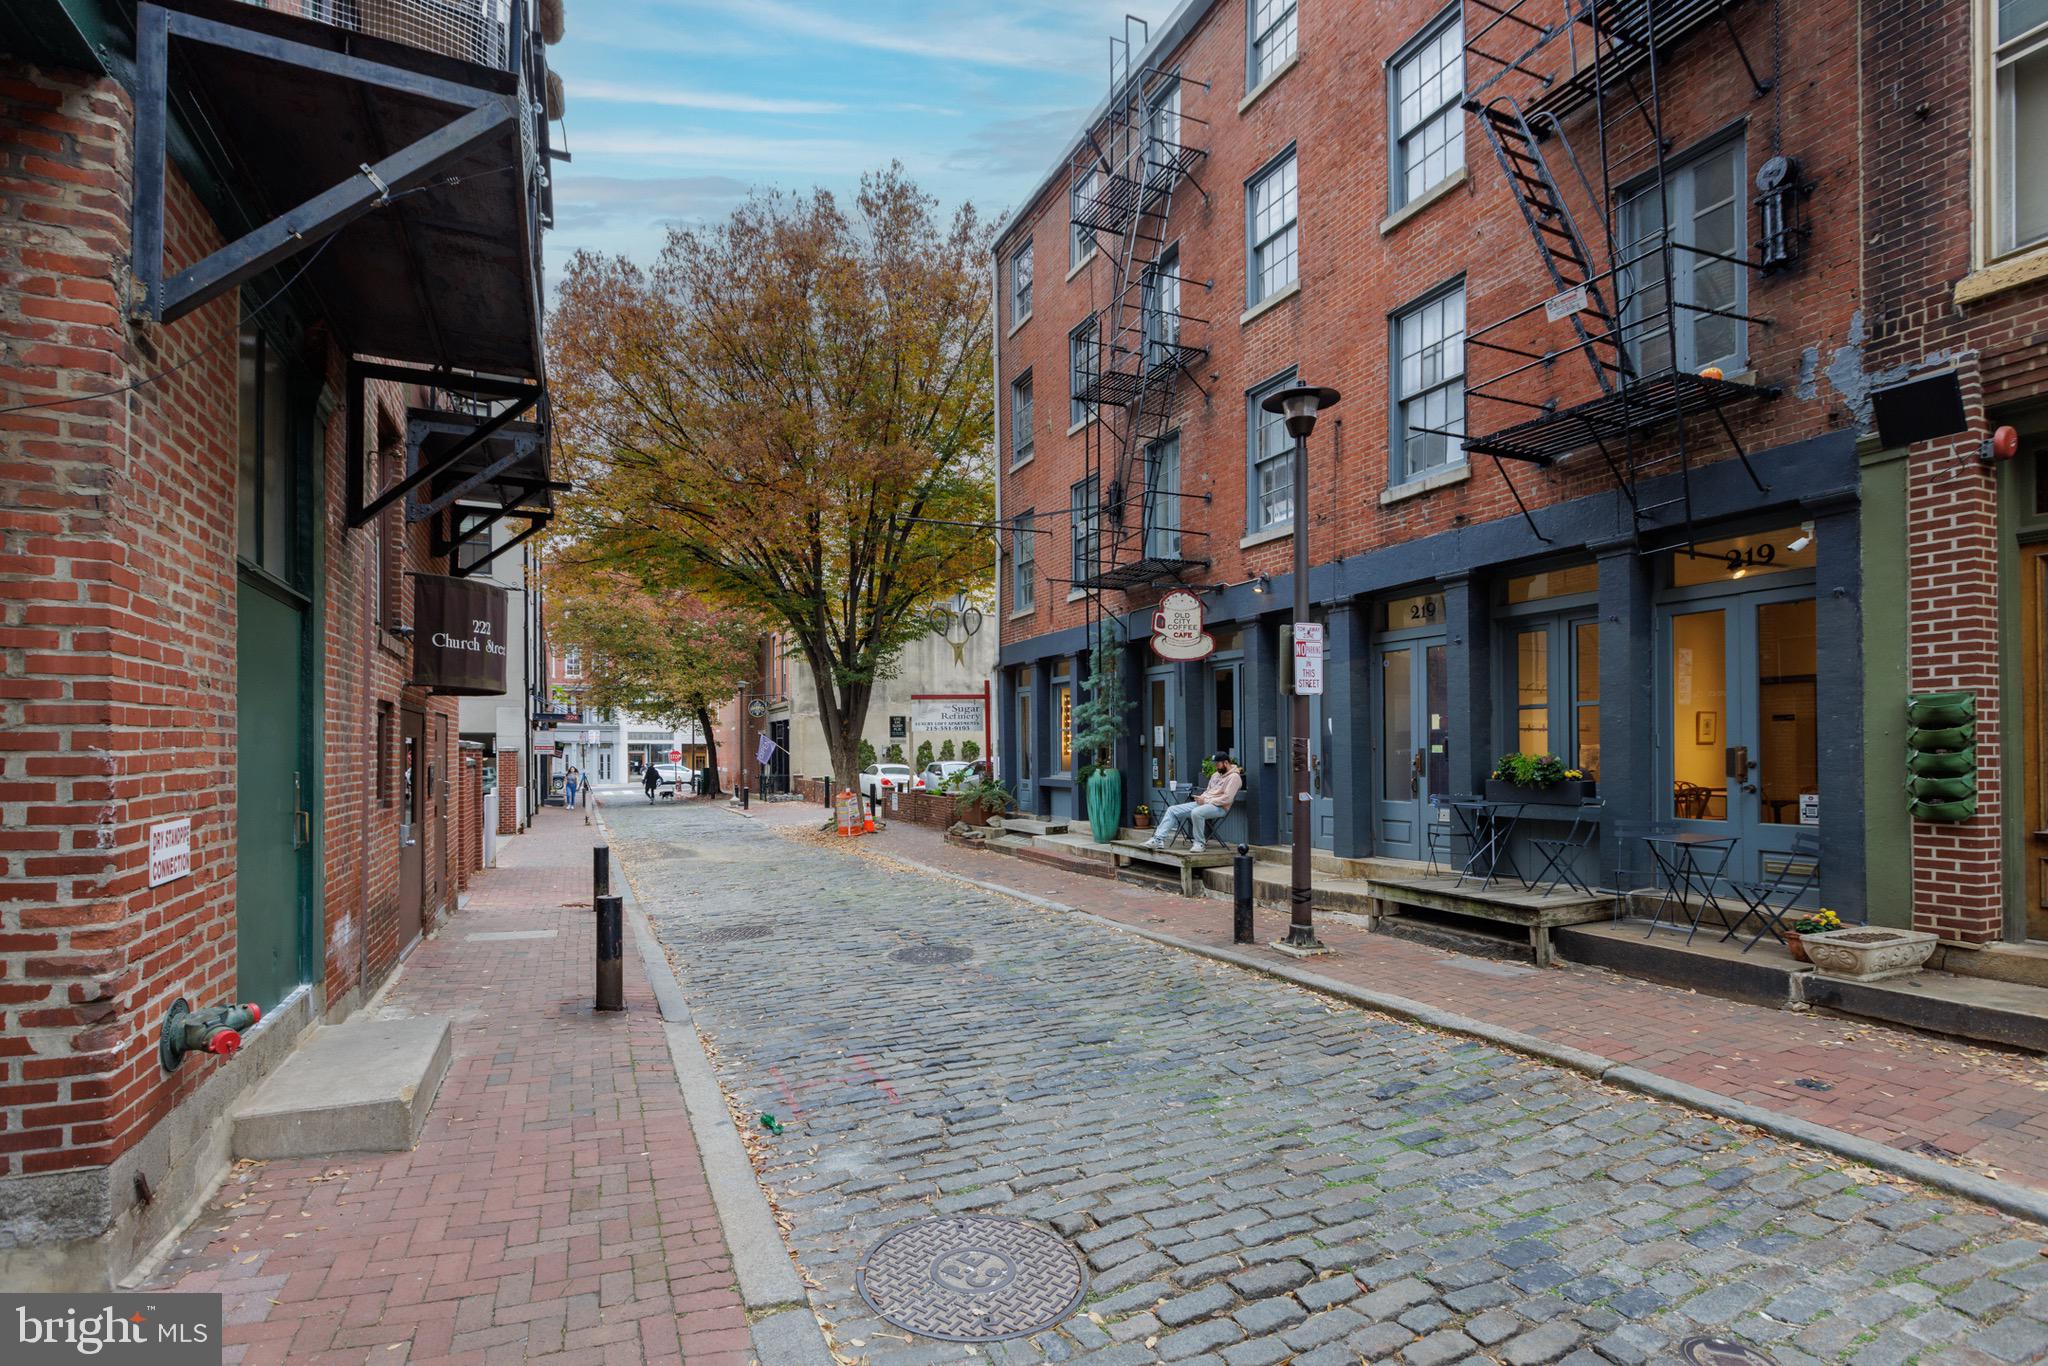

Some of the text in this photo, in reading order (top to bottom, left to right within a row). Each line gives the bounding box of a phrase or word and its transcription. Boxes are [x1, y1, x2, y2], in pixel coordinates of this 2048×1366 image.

[1725, 543, 1775, 570] 219
[1410, 602, 1436, 620] 219
[472, 619, 491, 635] 222
[431, 632, 480, 651] Church
[1296, 643, 1321, 656] NO PARKING
[1302, 669, 1316, 678] THIS
[1298, 679, 1320, 688] STREET
[941, 712, 981, 721] Refinery
[952, 704, 981, 714] Sugar
[758, 740, 769, 759] OPEN
[153, 825, 190, 852] DRY STANDPIPE
[153, 853, 190, 881] CONNECTION
